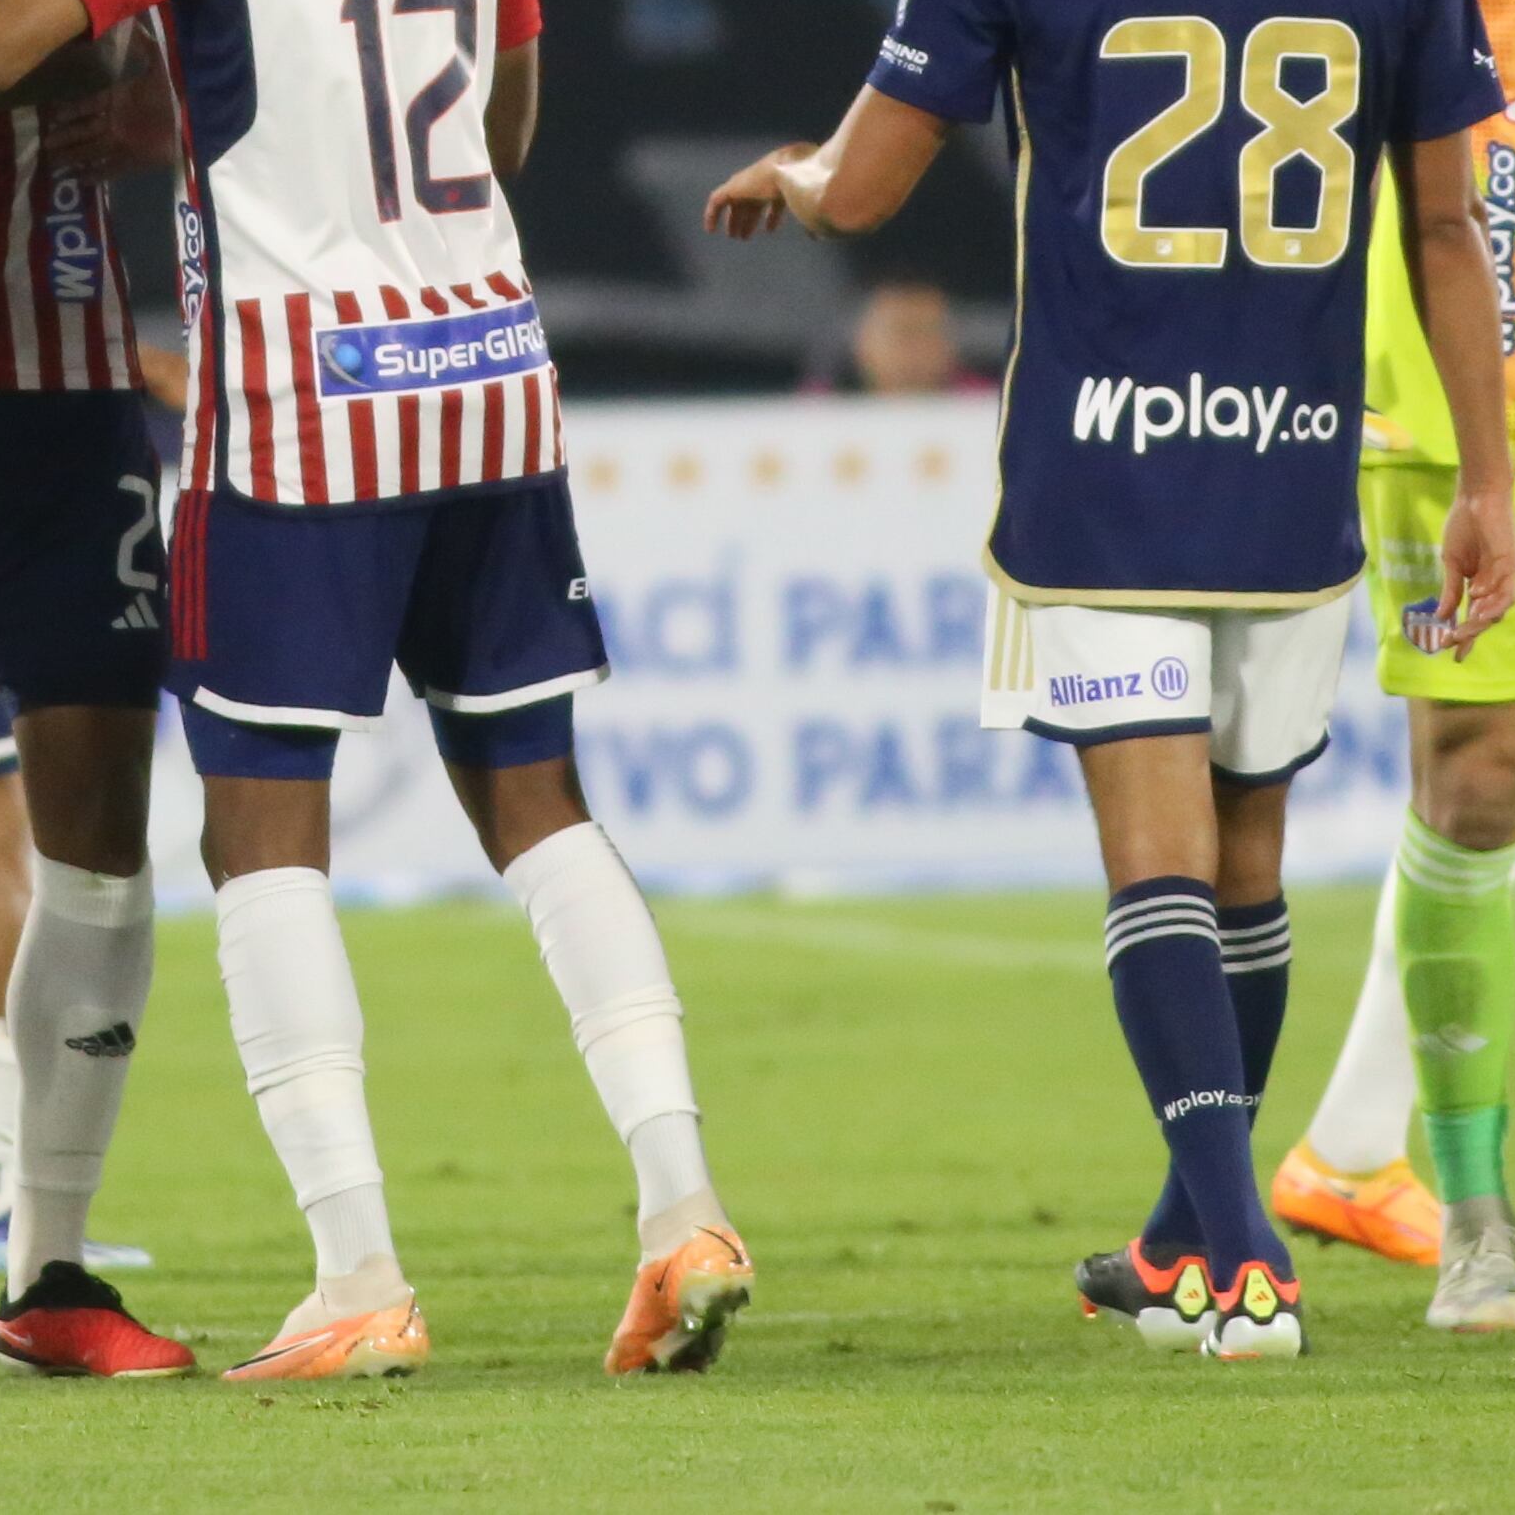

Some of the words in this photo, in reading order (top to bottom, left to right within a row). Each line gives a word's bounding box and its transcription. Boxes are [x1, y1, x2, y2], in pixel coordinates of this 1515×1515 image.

[1099, 15, 1361, 269] 28
[1074, 372, 1339, 453] Wplay.co
[1049, 673, 1144, 707] Allianz
